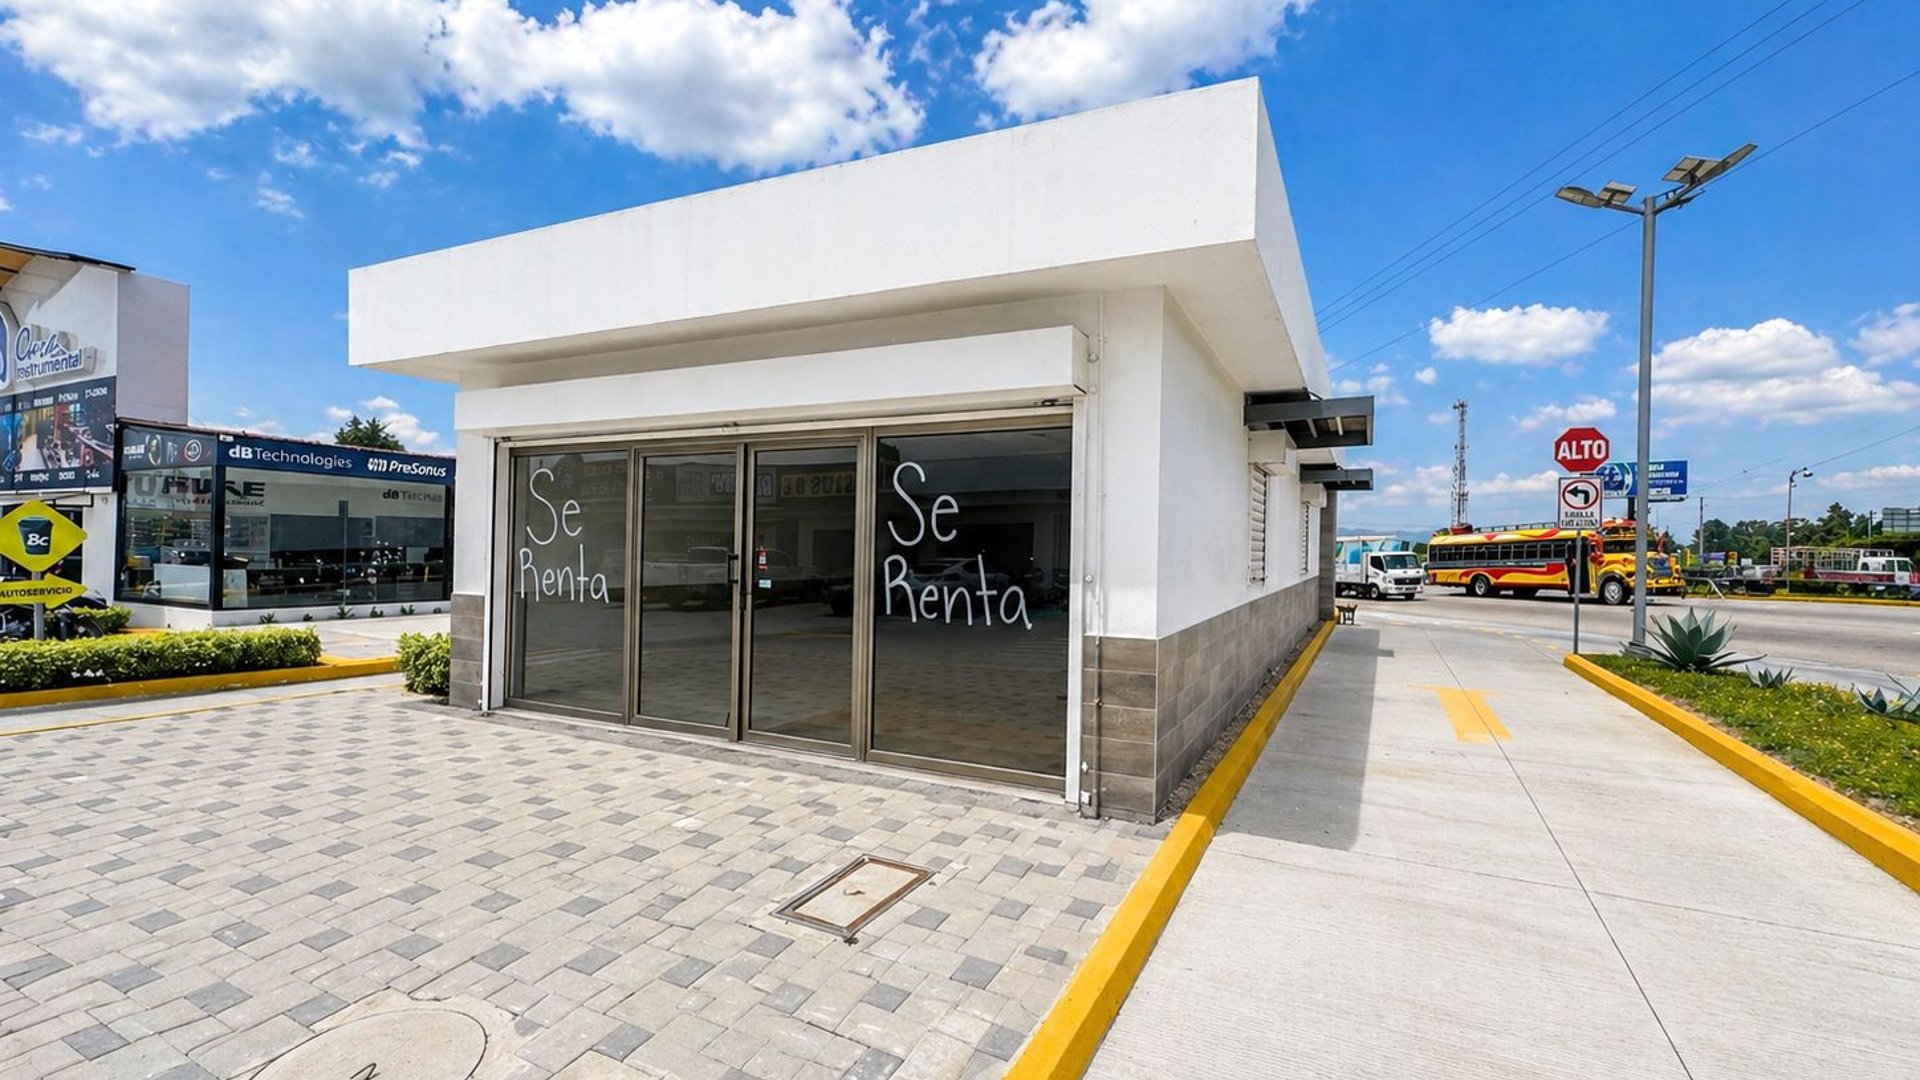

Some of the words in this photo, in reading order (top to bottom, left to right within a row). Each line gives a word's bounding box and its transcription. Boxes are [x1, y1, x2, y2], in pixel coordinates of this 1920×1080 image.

[388, 461, 447, 477] PreSonus
[1557, 440, 1607, 461] ALTO
[526, 467, 583, 546] Se
[887, 461, 959, 547] Se
[0, 586, 73, 599] AUTOSERVICIO
[519, 543, 610, 604] Renta
[884, 554, 1033, 631] Renta
